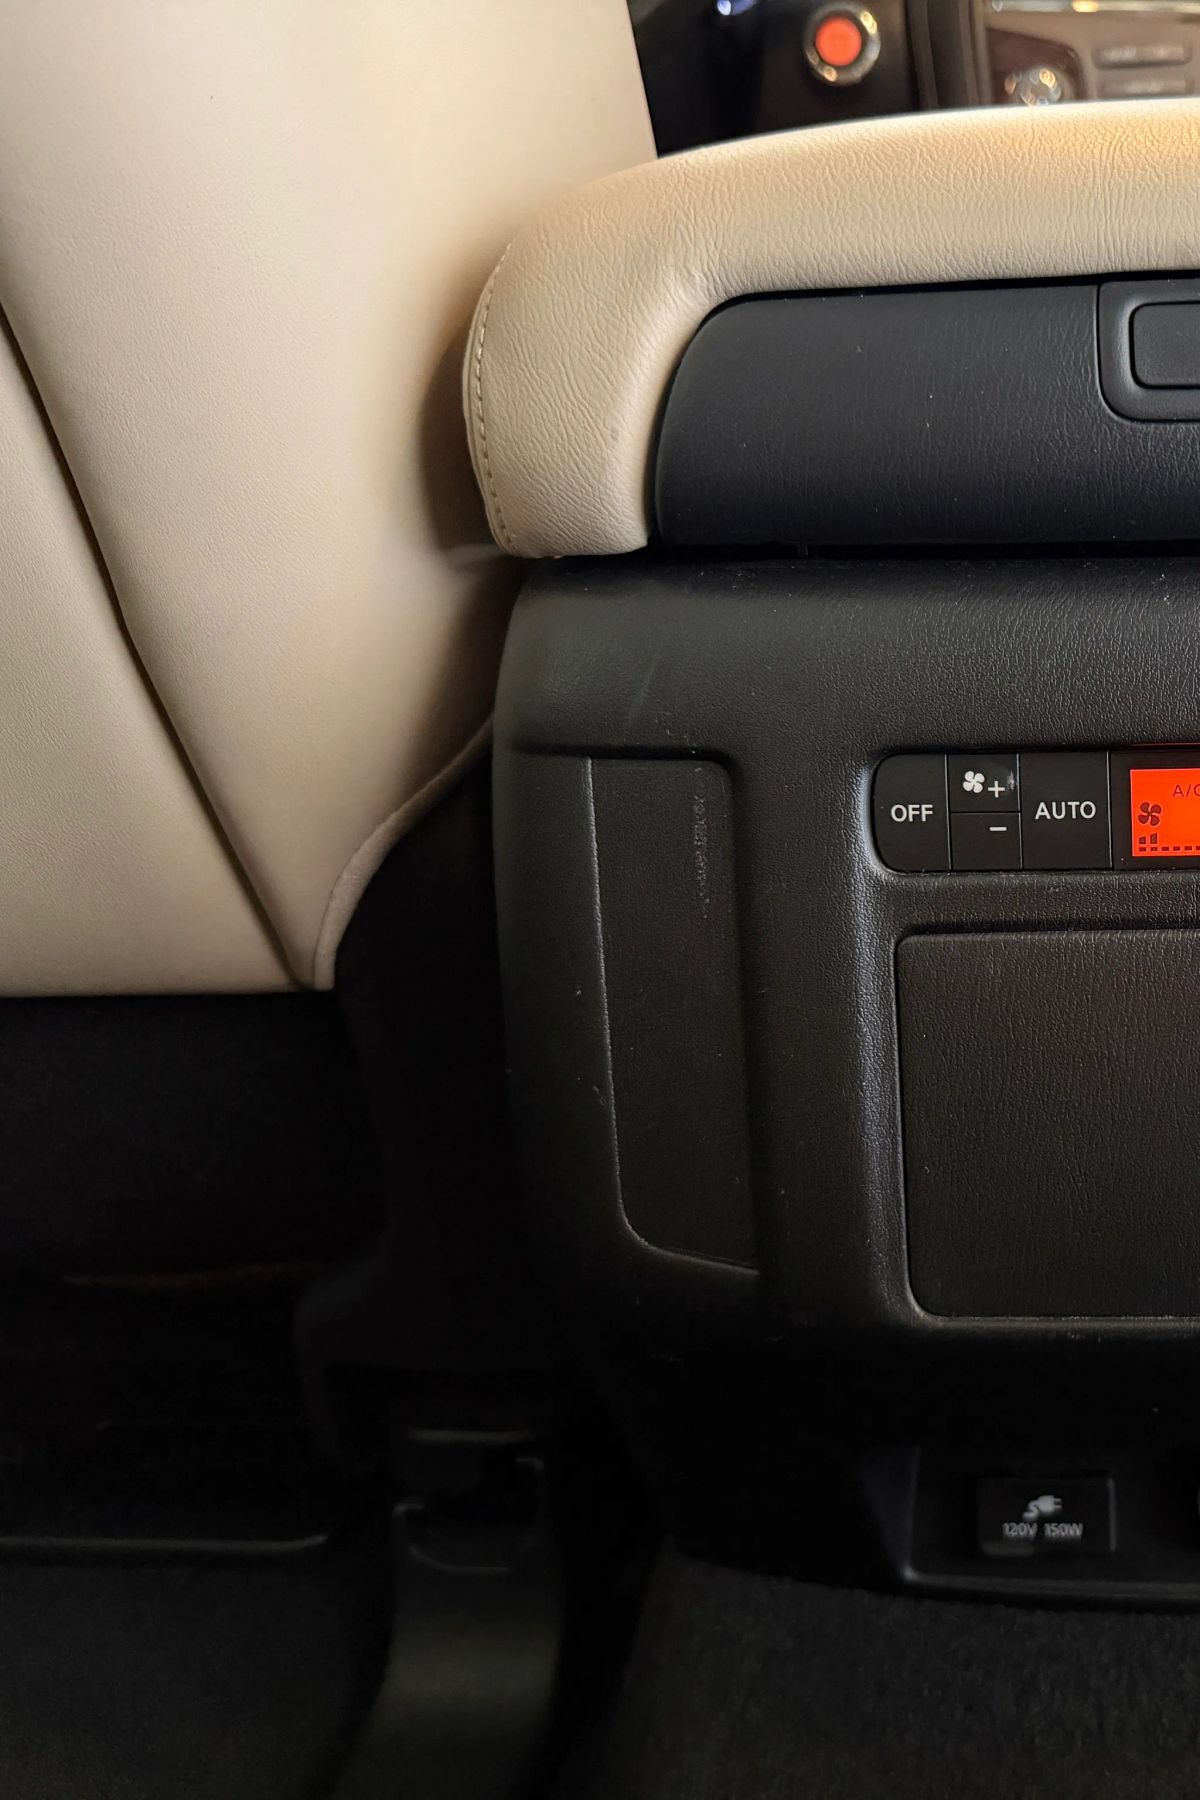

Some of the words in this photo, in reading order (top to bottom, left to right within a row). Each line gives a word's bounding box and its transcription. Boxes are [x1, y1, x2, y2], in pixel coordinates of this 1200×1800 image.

[890, 804, 933, 822] OFF
[1034, 801, 1097, 820] AUTO
[1002, 1523, 1037, 1539] 120V
[1045, 1523, 1083, 1539] 150W
